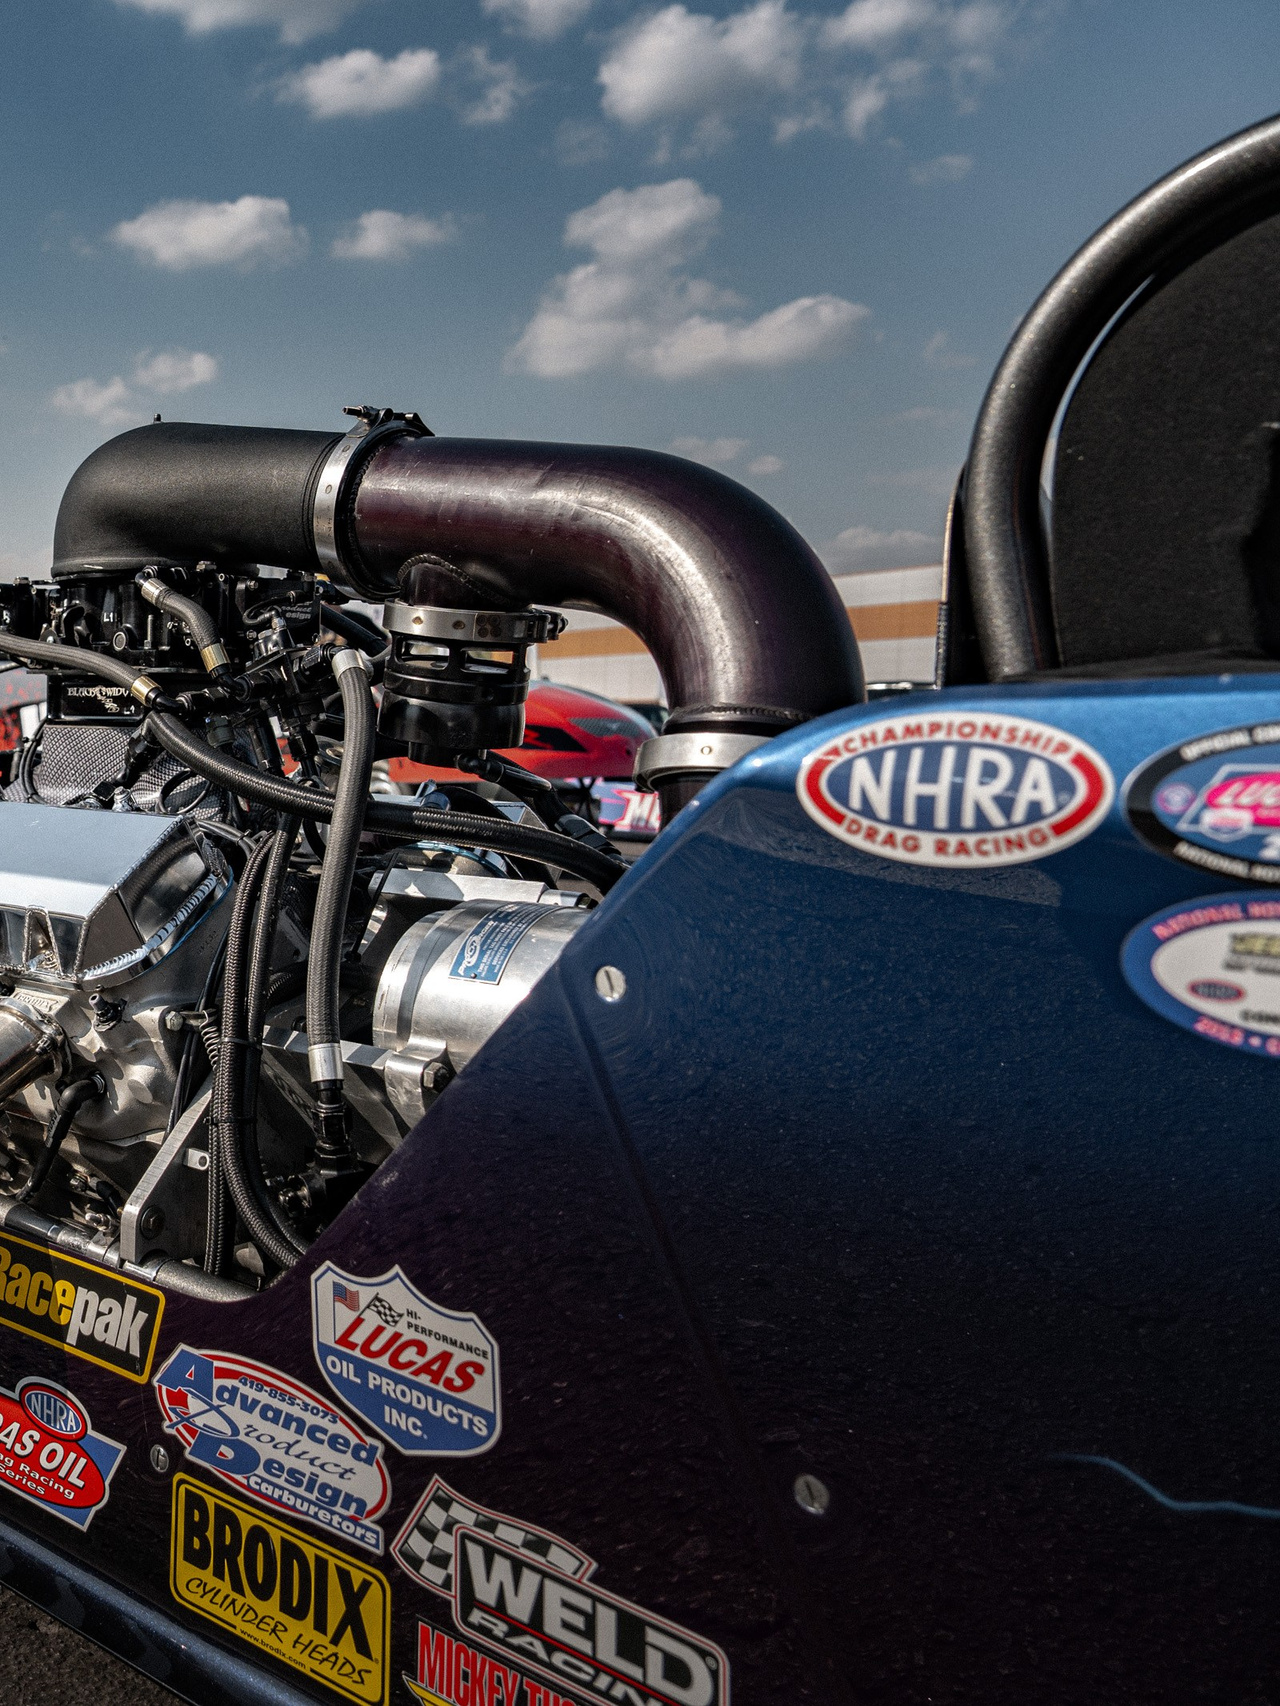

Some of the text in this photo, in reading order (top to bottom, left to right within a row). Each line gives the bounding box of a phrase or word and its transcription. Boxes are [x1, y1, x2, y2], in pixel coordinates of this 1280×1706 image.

[281, 605, 312, 613] roduct
[285, 611, 311, 620] esign
[843, 720, 1072, 755] CHAMPIONSHIP
[848, 745, 1058, 830] NHRA
[845, 817, 1049, 857] DRAG RACING
[406, 1308, 421, 1321] HI-
[407, 1322, 489, 1360] PERFORMANCE
[335, 1316, 486, 1393] LUCAS
[30, 1394, 77, 1432] NHRA
[155, 1349, 380, 1467] Advanced
[238, 1376, 340, 1425] 419-855-3073
[326, 1355, 489, 1437] OIL PRODUCTS
[39, 1442, 88, 1490] OIL
[166, 1388, 358, 1481] Product
[19, 1463, 75, 1500] Racing
[188, 1431, 370, 1518] Design
[183, 1487, 374, 1662] BRODIX
[185, 1577, 372, 1686] CYLINDER HEADS
[239, 1628, 307, 1670] www.brodix.com
[465, 1538, 714, 1706] WELD
[419, 1621, 521, 1706] MICKEY
[467, 1607, 665, 1706] RACIN
